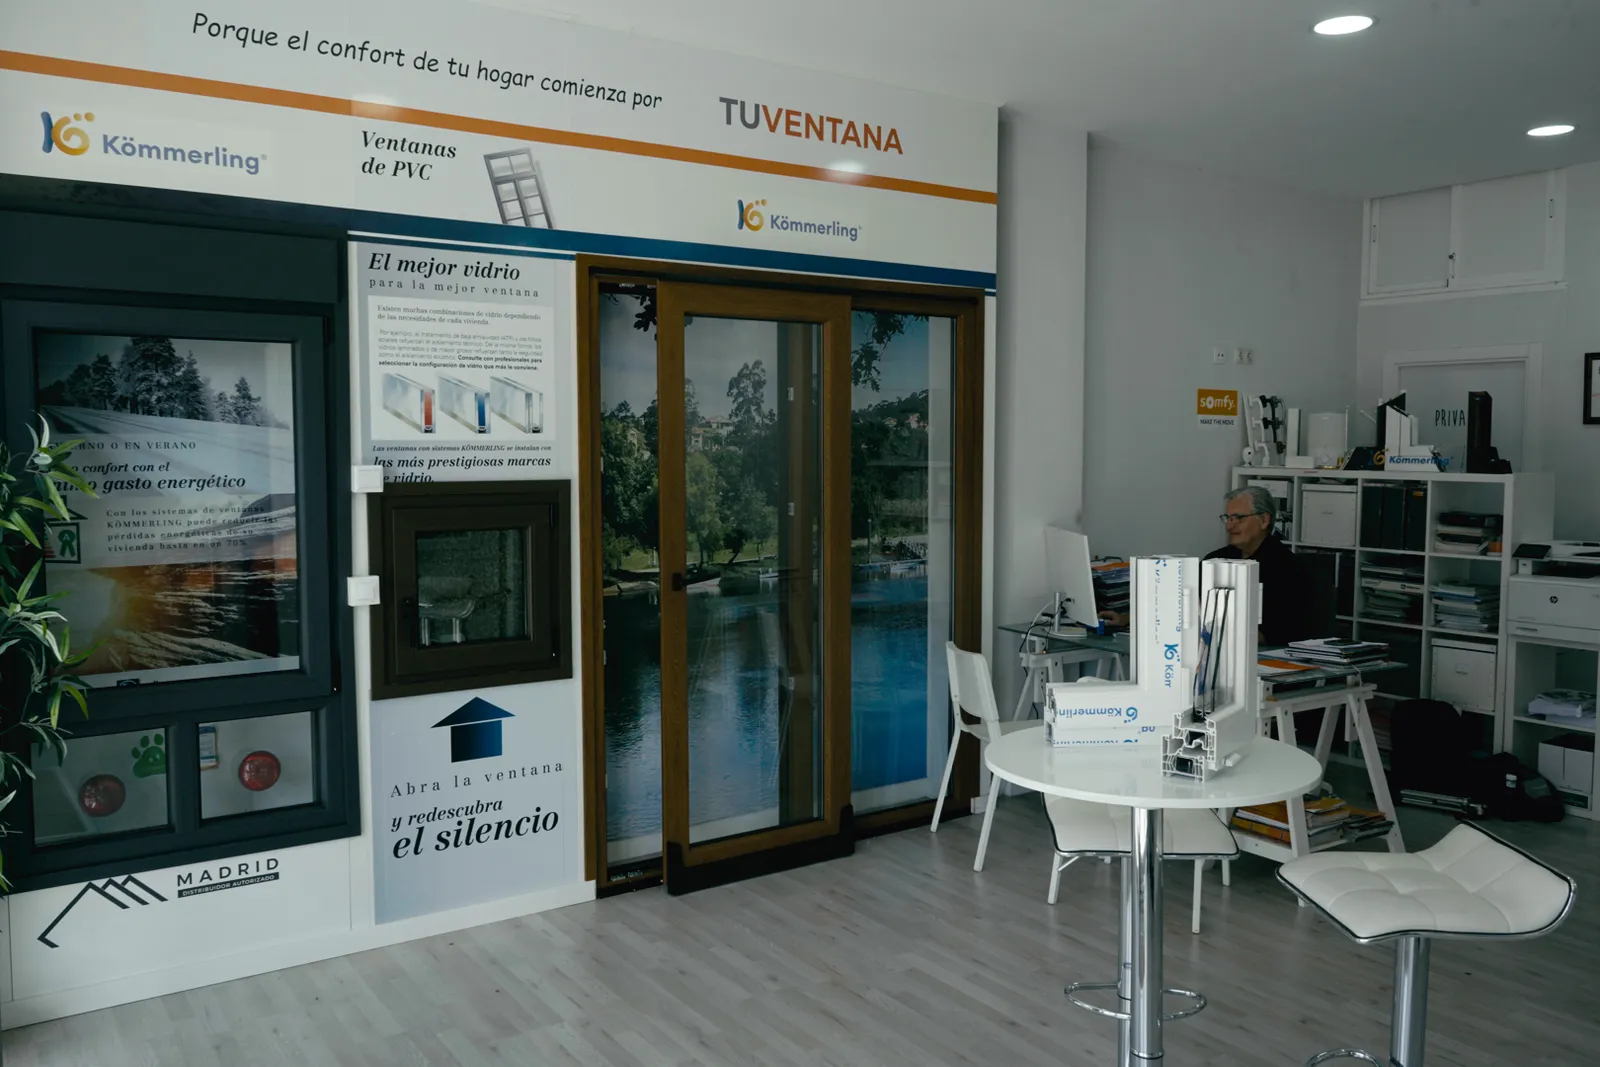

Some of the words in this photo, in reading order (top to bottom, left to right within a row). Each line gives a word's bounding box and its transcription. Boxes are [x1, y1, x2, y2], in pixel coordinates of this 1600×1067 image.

[192, 12, 279, 48] Porque
[287, 30, 309, 52] el
[316, 37, 406, 68] confort
[412, 49, 440, 73] de
[447, 56, 471, 79] tu
[477, 61, 535, 90] hogar
[540, 74, 627, 104] comienza
[633, 89, 664, 111] por
[718, 96, 904, 155] TUVENTANA
[361, 130, 457, 159] Ventanas
[361, 158, 387, 176] de
[391, 161, 433, 182] PVC
[368, 252, 391, 271] El
[397, 257, 458, 279] mejor
[463, 260, 520, 280] vidrio
[369, 277, 404, 290] para
[412, 279, 426, 290] la
[434, 282, 476, 295] mejor
[484, 286, 540, 298] ventana
[429, 308, 475, 317] combinaciones
[503, 312, 541, 320] dependiendo
[110, 442, 119, 450] O
[124, 442, 141, 450] EN
[146, 441, 197, 450] VERANO
[460, 444, 506, 452] KÖMMERLING
[82, 462, 129, 476] confort
[132, 464, 154, 473] con
[158, 462, 170, 473] el
[397, 456, 425, 468] más
[427, 456, 504, 470] prestigiosas
[507, 455, 551, 467] marcas
[102, 477, 152, 494] gasto
[157, 475, 246, 493] energético
[106, 508, 127, 517] Con
[131, 508, 147, 516] los
[152, 508, 198, 517] sistemas
[202, 506, 215, 514] de
[219, 505, 265, 513] ventanas
[107, 519, 183, 529] KÖMMERLING
[187, 519, 217, 528] puede
[62, 533, 70, 541] A
[107, 532, 156, 542] pérdidas
[160, 529, 223, 539] energéticas
[107, 543, 155, 552] vivienda
[226, 539, 247, 547] 70%
[390, 781, 441, 798] Abra
[454, 775, 472, 788] la
[484, 762, 564, 783] ventana
[391, 816, 402, 832] y
[407, 799, 504, 827] redescubra
[393, 826, 425, 859] el
[434, 806, 559, 852] silencio
[177, 858, 279, 887] MADRID
[182, 883, 231, 896] DISTRIBUIDOR
[232, 875, 275, 887] AUTORIZADO
